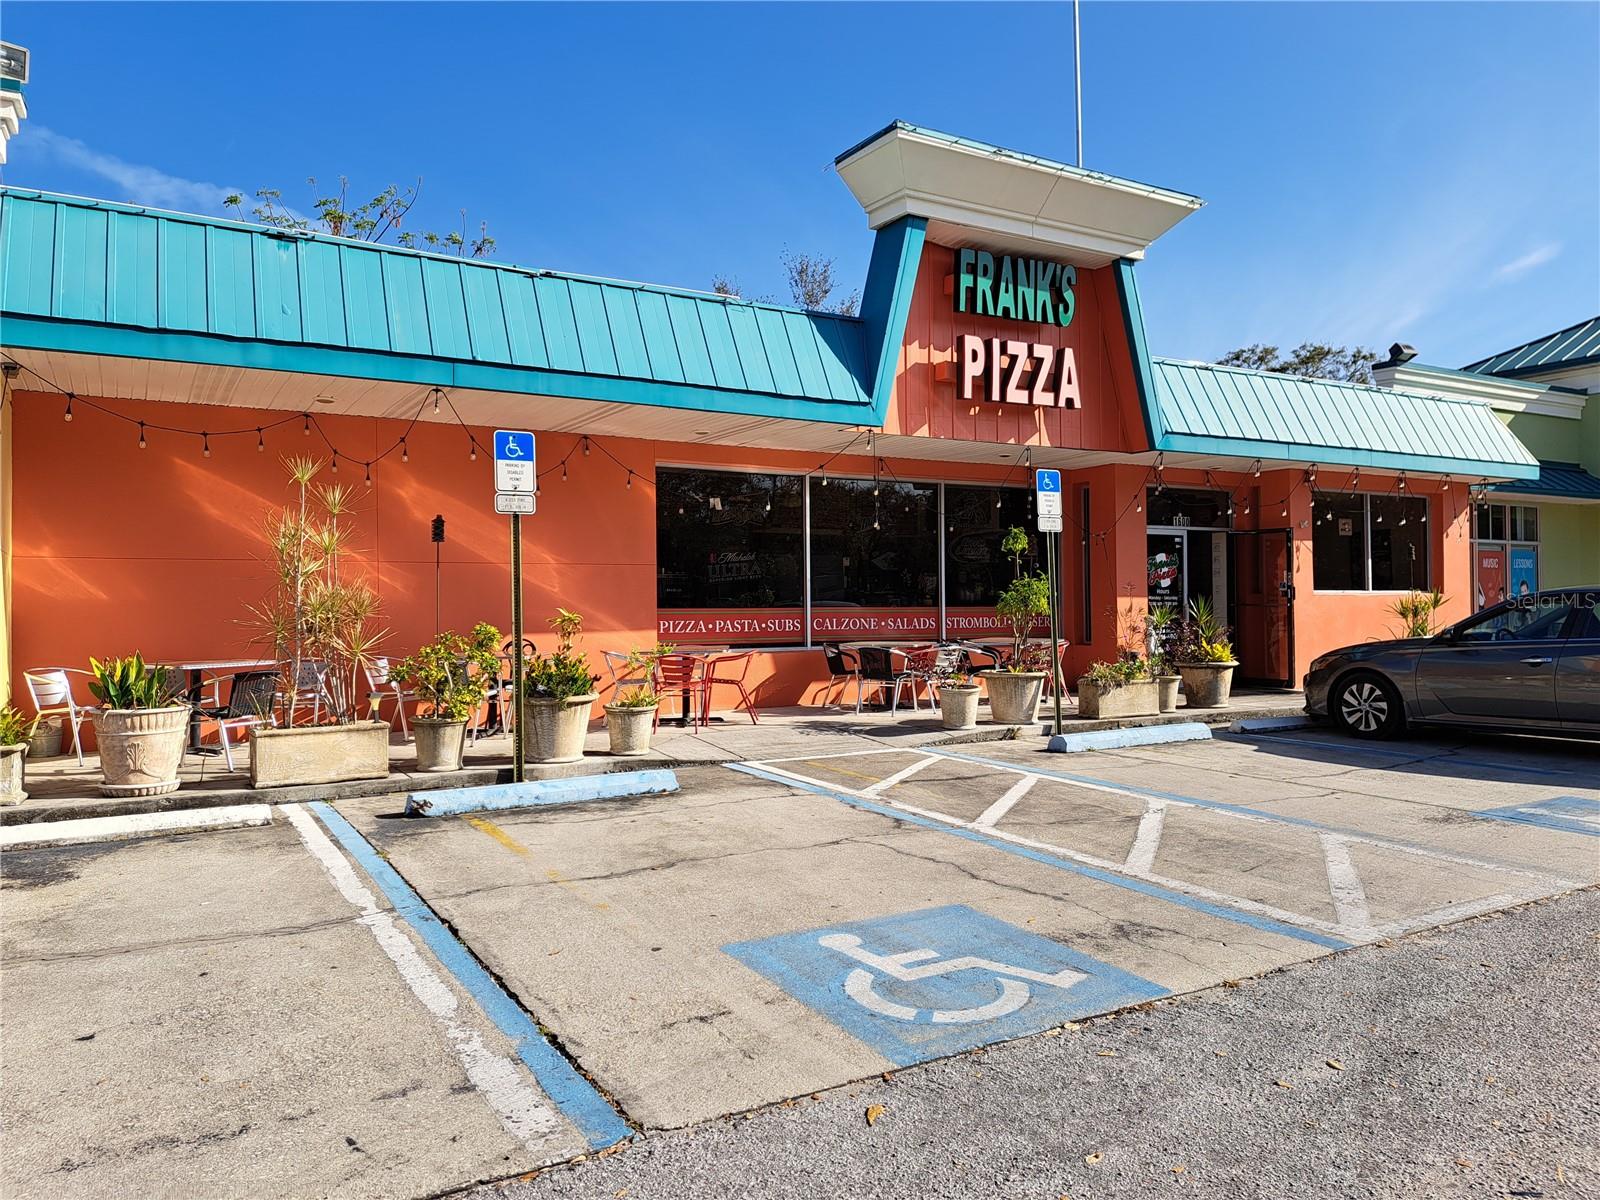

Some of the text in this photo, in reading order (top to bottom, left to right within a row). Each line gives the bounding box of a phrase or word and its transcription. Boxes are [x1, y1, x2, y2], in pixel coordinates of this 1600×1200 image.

[956, 248, 1076, 327] FRANK'S
[958, 334, 1082, 409] PIZZA
[708, 560, 762, 577] ULTRA
[1483, 558, 1499, 568] MUSIC
[1513, 558, 1534, 568] LESSONS
[659, 619, 801, 634] PIZZA PASTA SUBS
[813, 617, 936, 630] CALZONE SALADS
